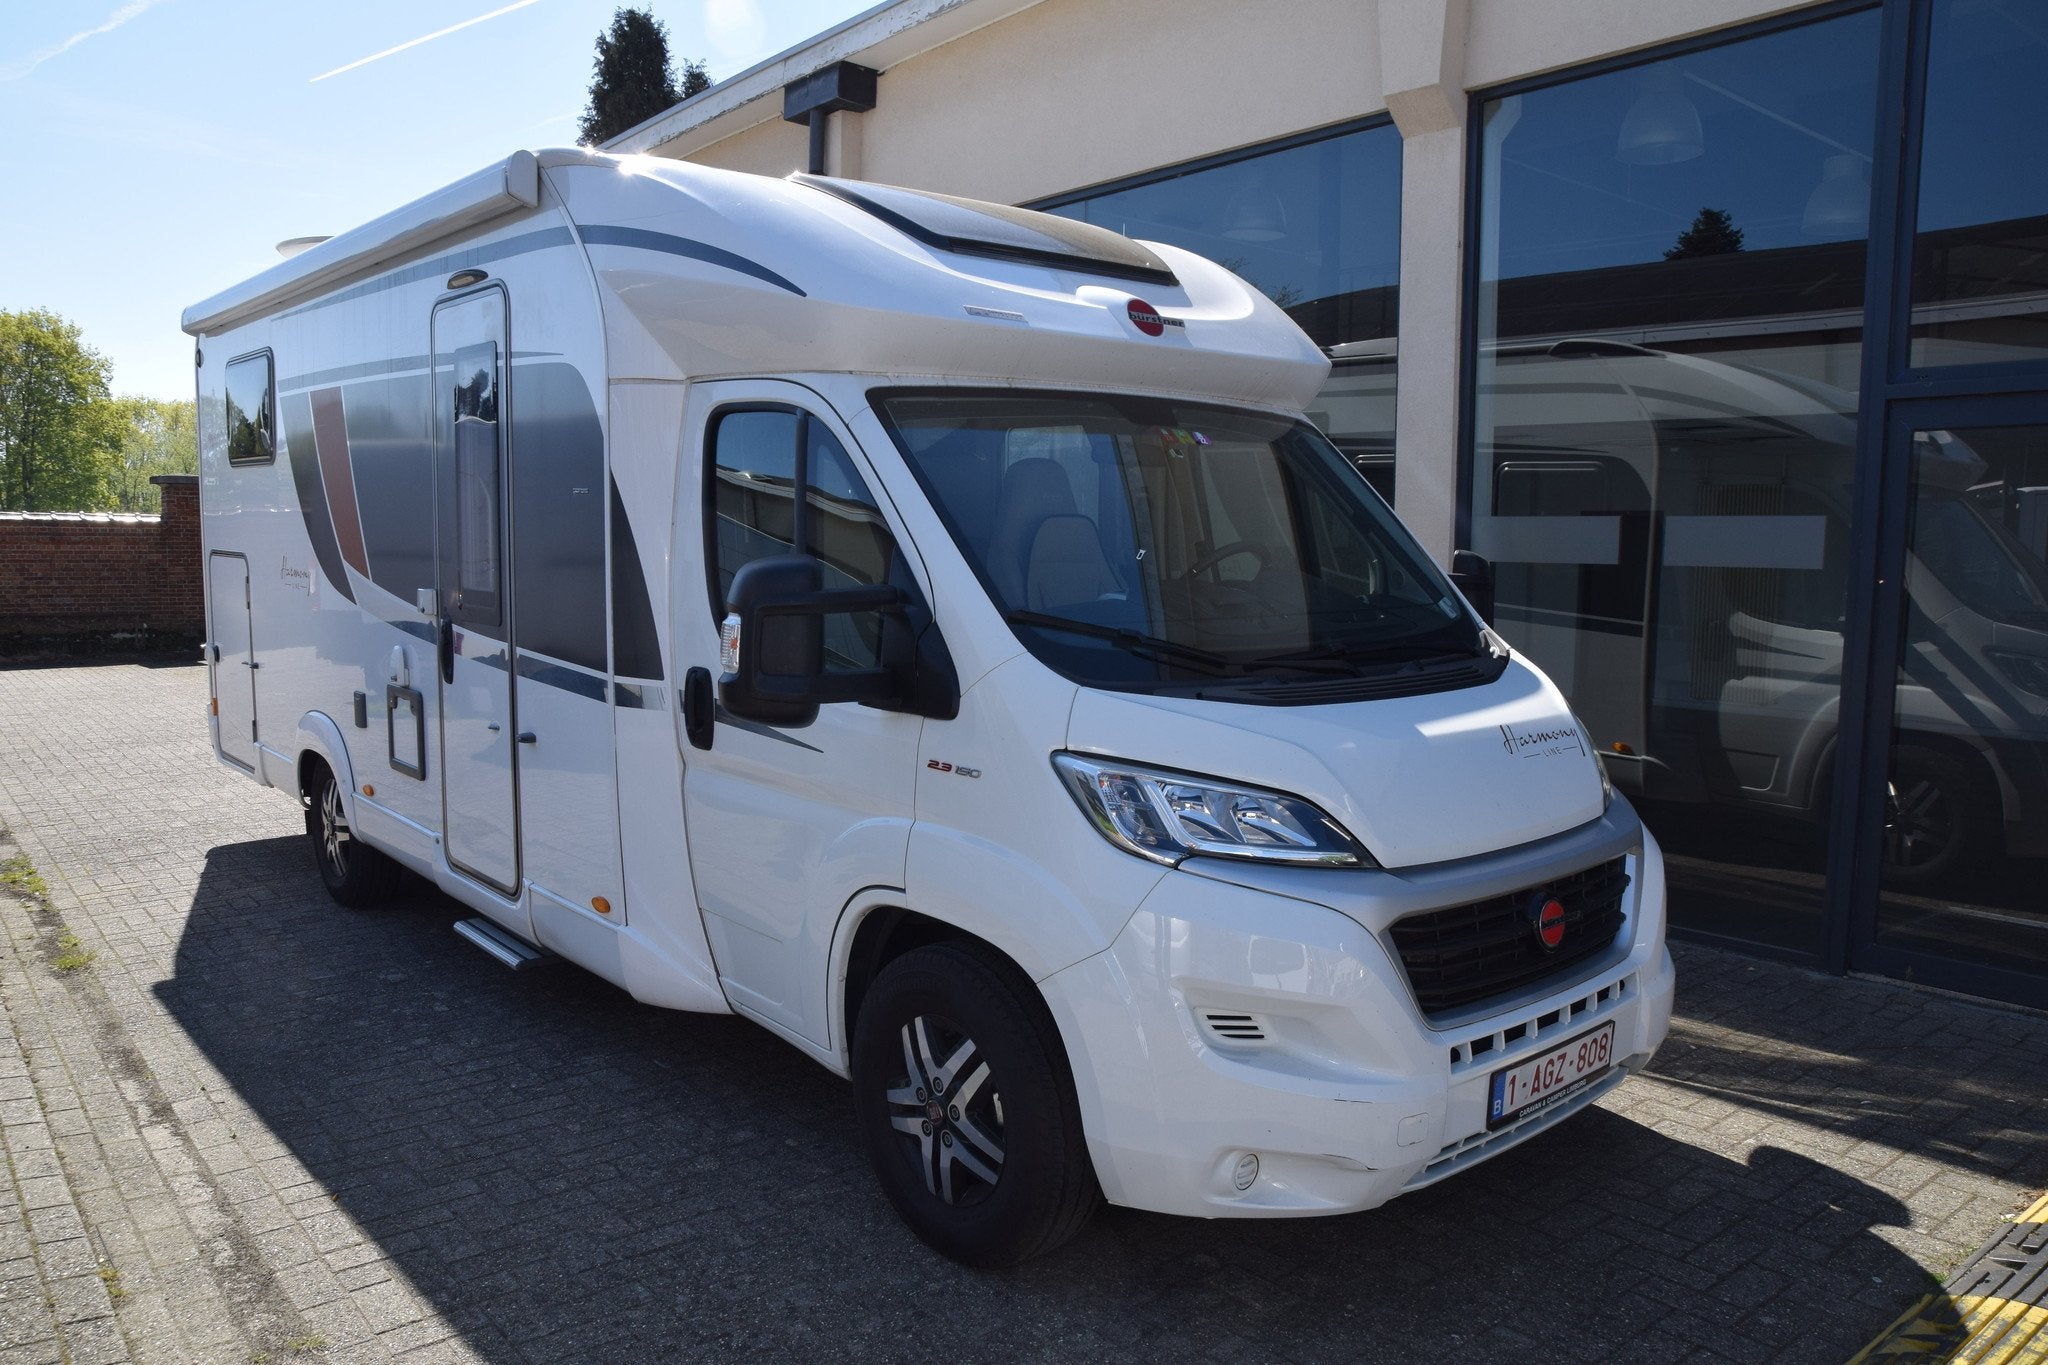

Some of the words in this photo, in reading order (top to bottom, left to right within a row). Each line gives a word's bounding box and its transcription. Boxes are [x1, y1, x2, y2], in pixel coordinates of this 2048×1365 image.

[1128, 312, 1184, 327] bürstner
[1499, 724, 1586, 758] Harmony
[1543, 746, 1562, 757] LINE
[1519, 1101, 1542, 1117] CARAVAN
[1546, 1089, 1567, 1104] CAMPER
[1566, 1078, 1587, 1094] LIMBURG
[1493, 1099, 1502, 1115] B
